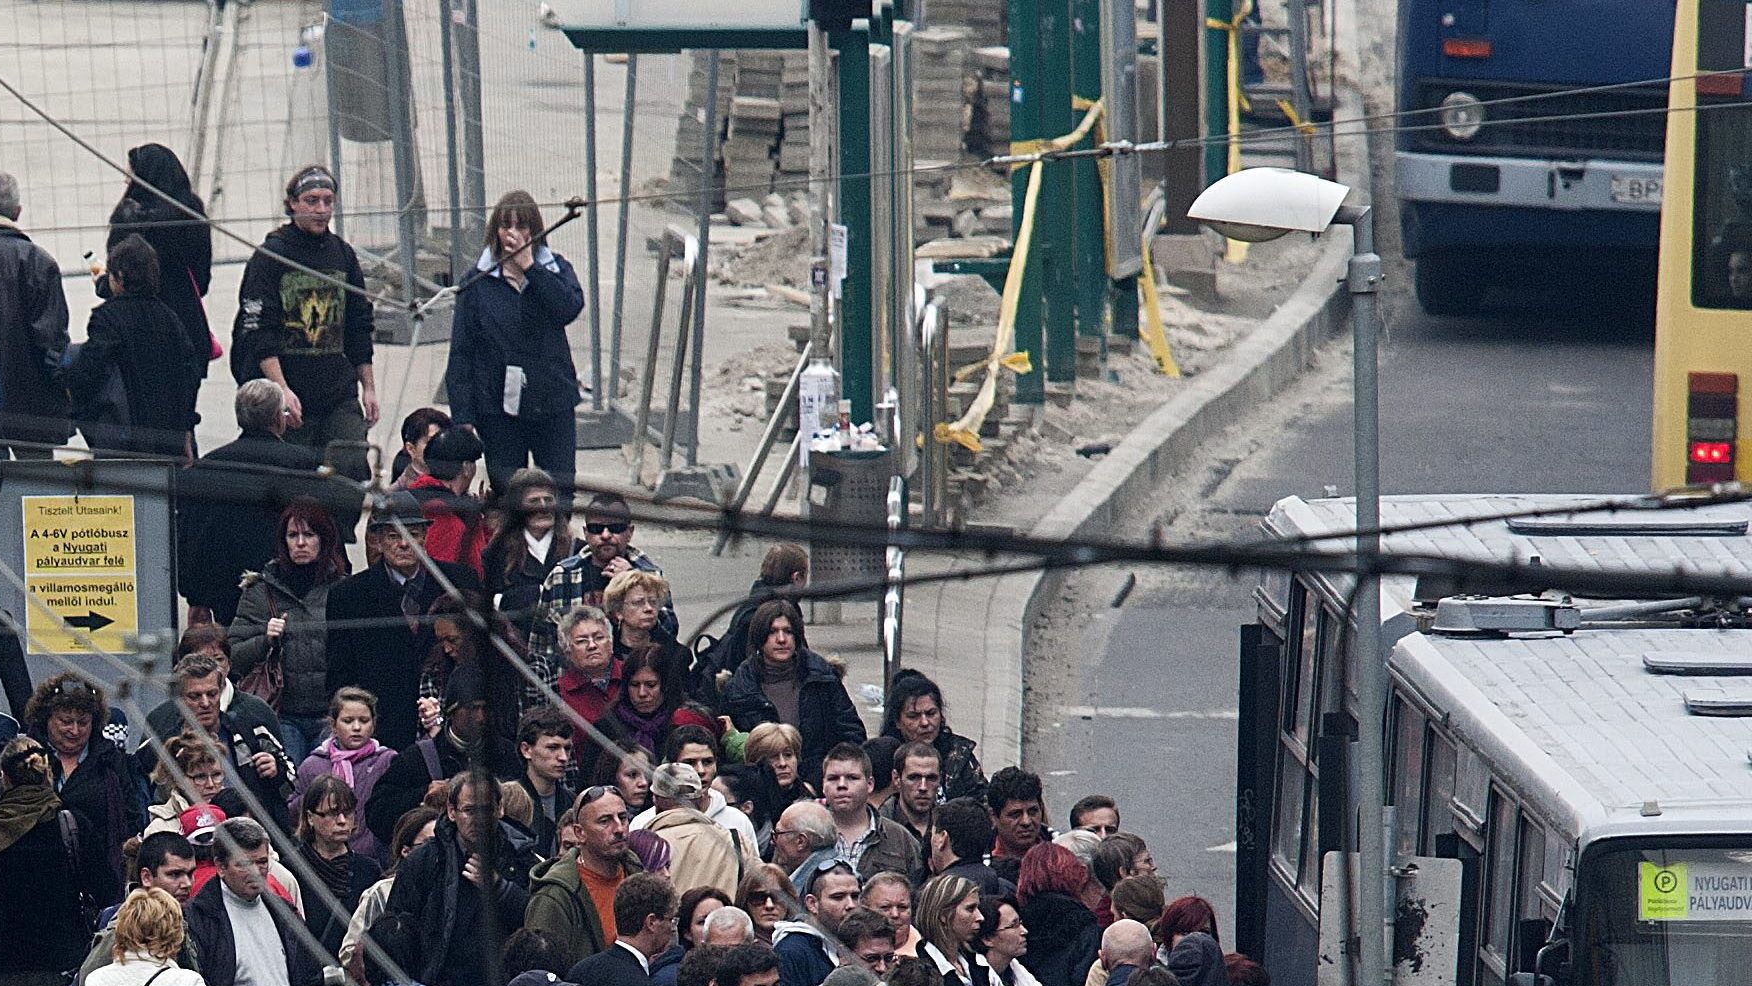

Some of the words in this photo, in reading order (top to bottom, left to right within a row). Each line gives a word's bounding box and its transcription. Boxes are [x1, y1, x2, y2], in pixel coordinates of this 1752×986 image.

[38, 506, 72, 516] Tisztelt
[76, 505, 122, 516] Utasaink!
[30, 529, 40, 539] A
[42, 528, 67, 539] 4-6V
[71, 527, 129, 540] pótlóbusz
[52, 544, 60, 552] a
[63, 541, 108, 554] Nyugati
[36, 556, 101, 568] pályaudvar
[103, 555, 125, 567] felé
[30, 584, 36, 592] a
[39, 582, 134, 595] villamosmegálló
[85, 595, 118, 606] indul.
[1689, 891, 1752, 910] PÁLYAUDV
